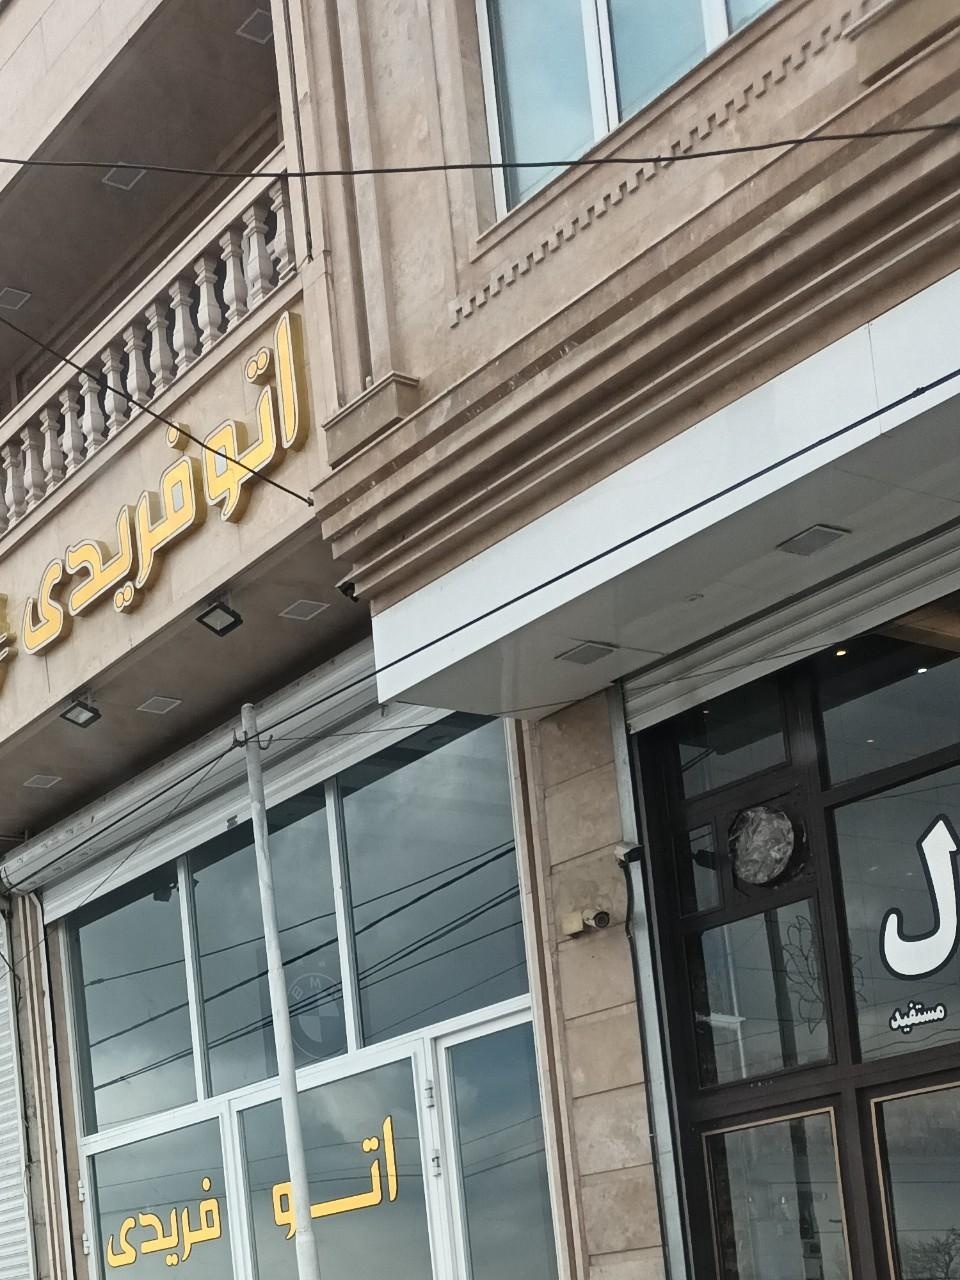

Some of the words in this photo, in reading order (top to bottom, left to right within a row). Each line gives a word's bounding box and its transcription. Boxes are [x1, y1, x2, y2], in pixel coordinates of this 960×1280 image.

[202, 310, 302, 521] اتو
[22, 421, 200, 656] فریدی
[890, 1003, 945, 1032] مستفید
[106, 1177, 222, 1269] فریدی
[271, 1114, 399, 1240] اتو
